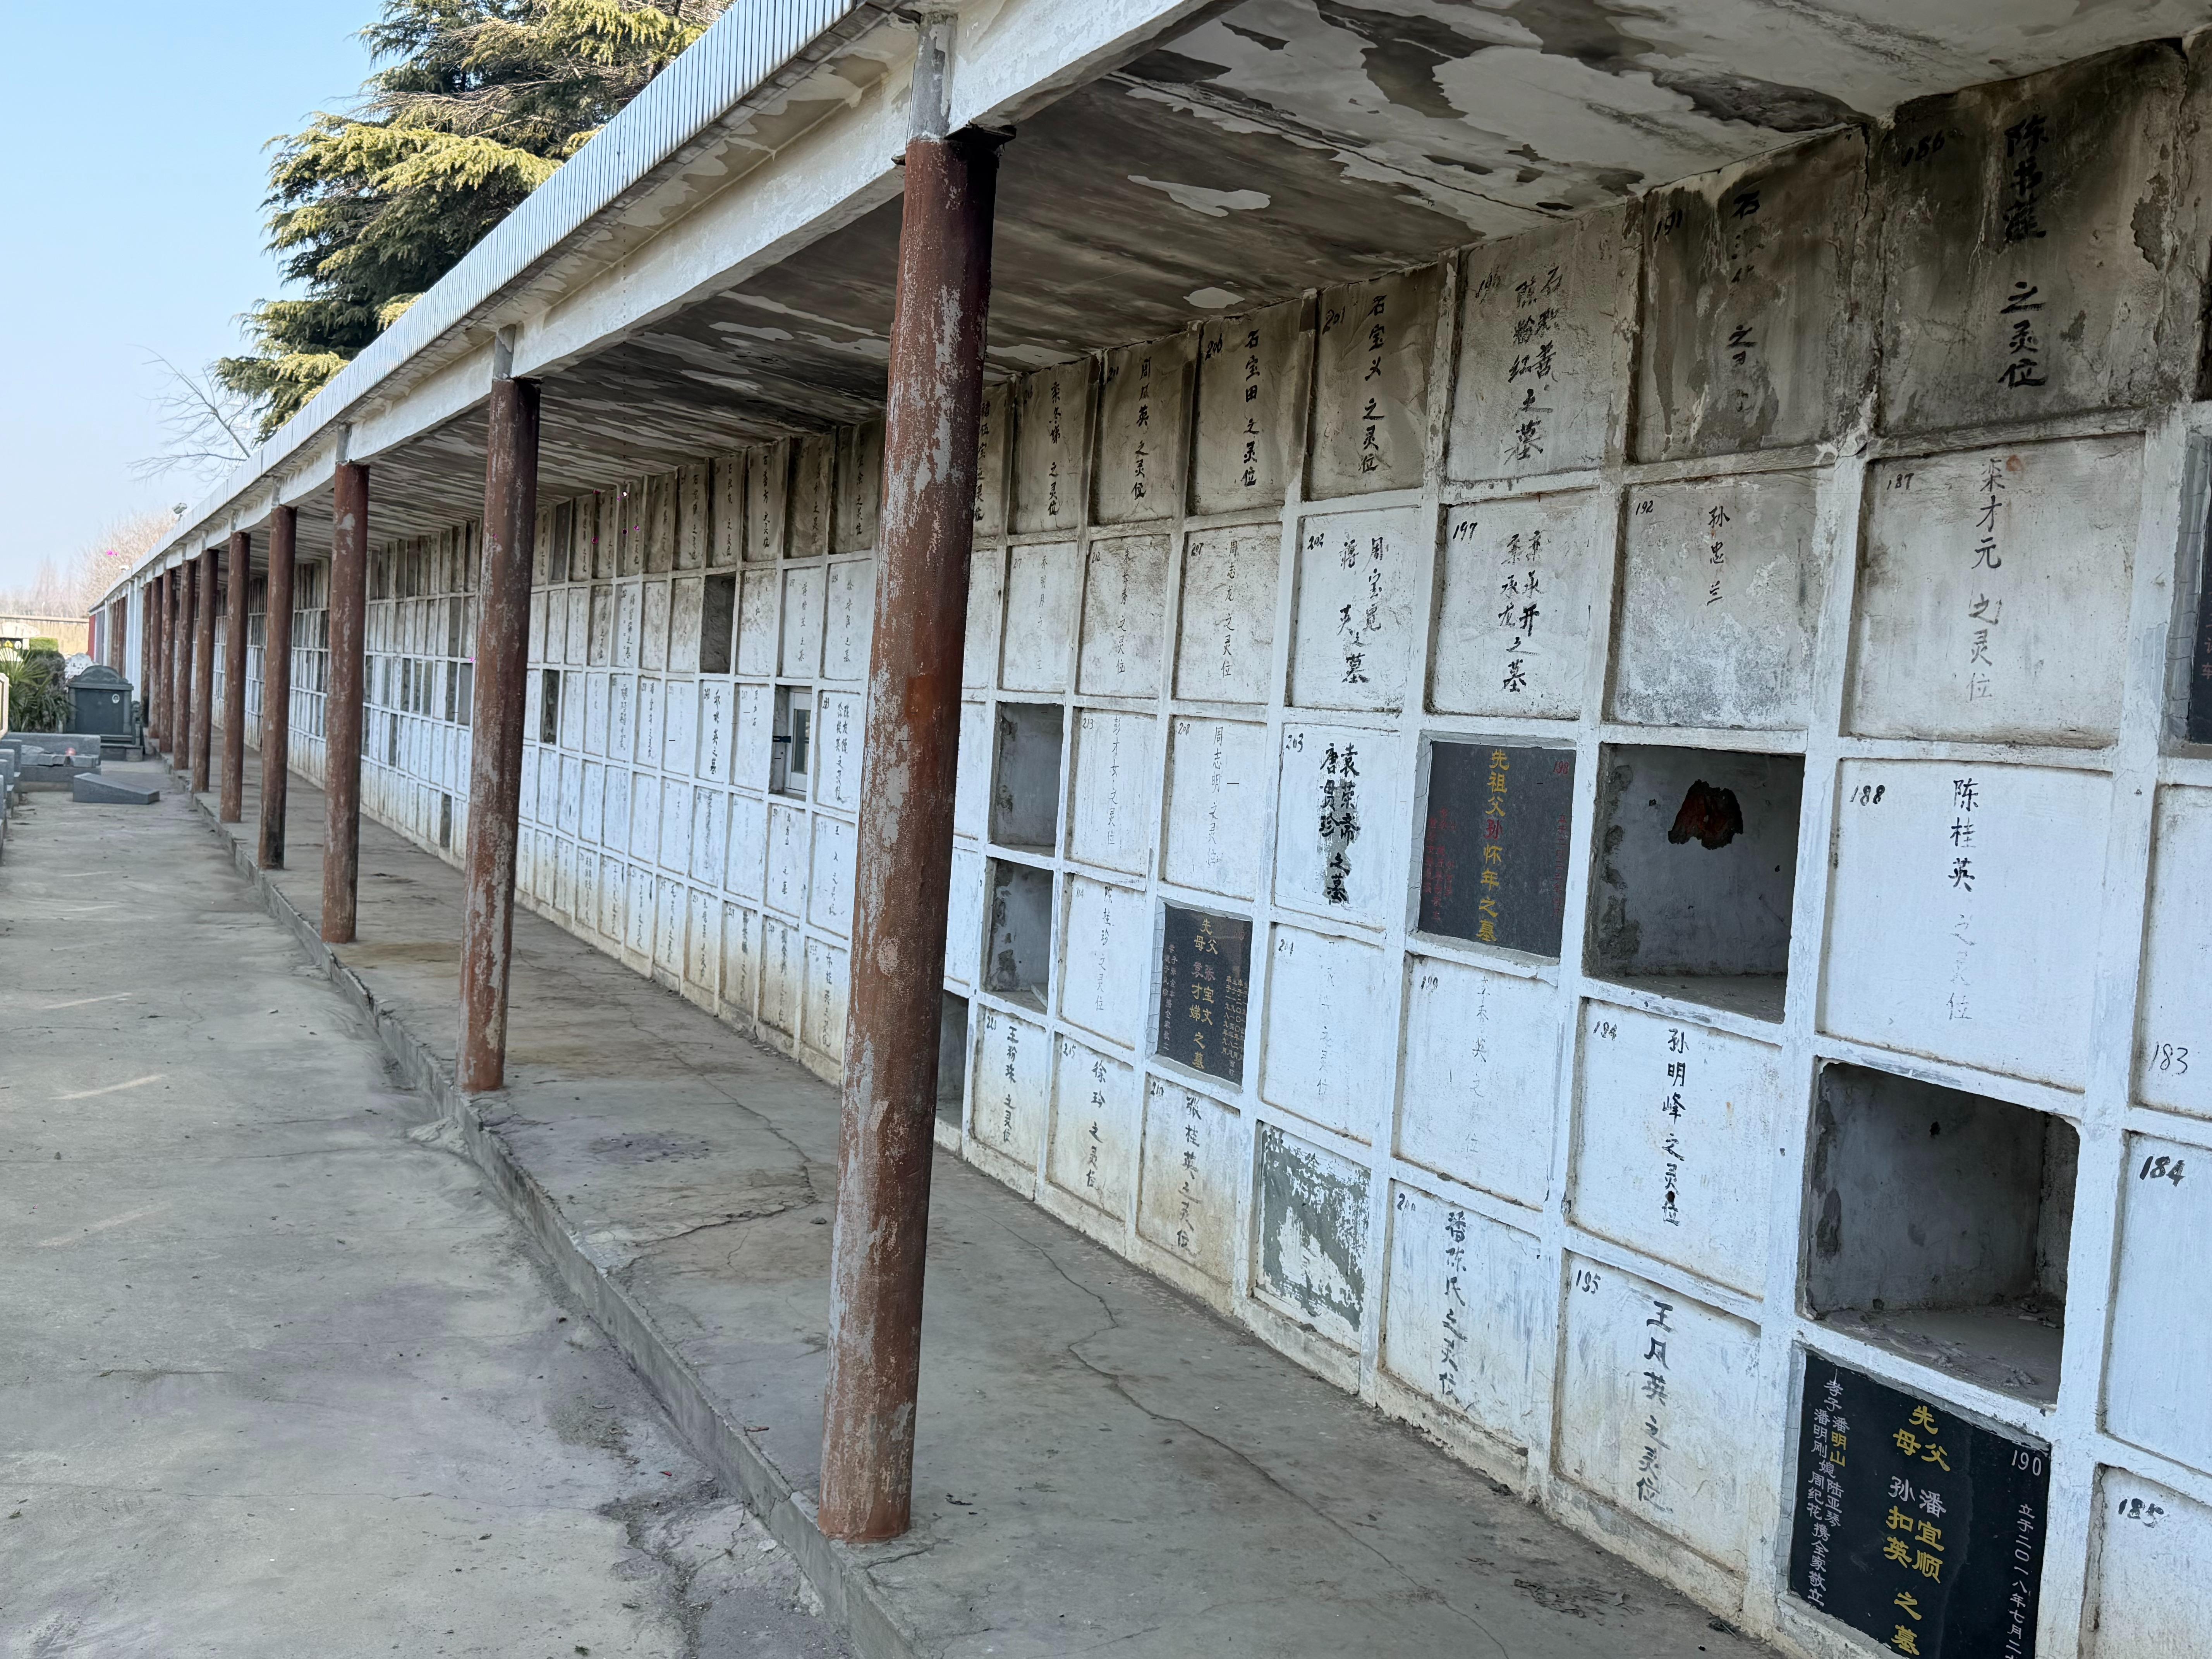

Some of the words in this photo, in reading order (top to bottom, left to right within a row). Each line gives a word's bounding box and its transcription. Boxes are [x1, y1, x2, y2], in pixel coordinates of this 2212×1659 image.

[1322, 306, 1345, 335] 201
[1887, 472, 1915, 491] 187
[1635, 500, 1654, 515] 192
[1452, 521, 1478, 543] 197
[1082, 718, 1094, 729] 213
[1178, 722, 1190, 735] 208
[1286, 733, 1304, 752] 203
[1849, 784, 1886, 807] 188
[2148, 1042, 2188, 1075] 183
[1661, 1028, 1689, 1226] 孙明峰之灵位
[2139, 1156, 2186, 1187] 184
[2011, 1449, 2042, 1476] 190
